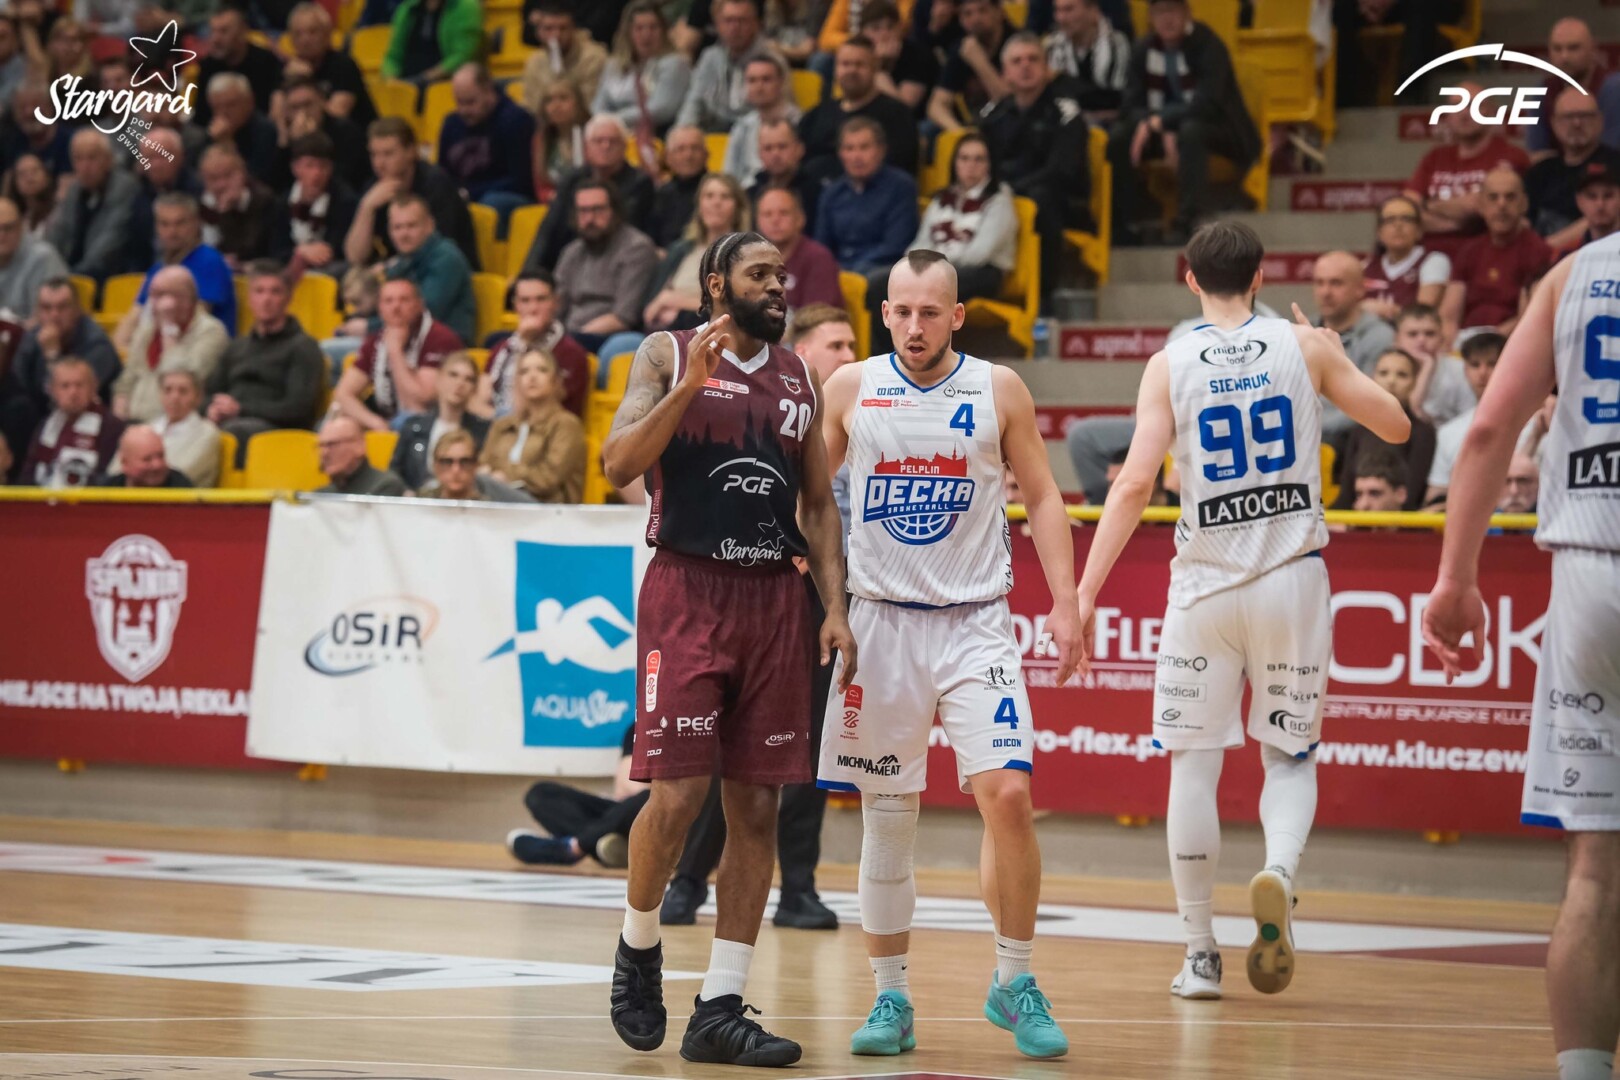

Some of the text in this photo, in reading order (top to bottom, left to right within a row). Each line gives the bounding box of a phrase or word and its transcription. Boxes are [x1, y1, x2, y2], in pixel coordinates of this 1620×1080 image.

[779, 398, 812, 443] 20
[949, 403, 975, 437] 4
[1198, 395, 1297, 482] 99
[722, 474, 775, 496] PGE
[900, 465, 940, 475] PELPLIN
[866, 478, 974, 510] DECKA
[887, 503, 949, 514] BASKETBALL
[1203, 489, 1306, 524] LATOCHA
[712, 537, 785, 567] Stargard
[993, 697, 1019, 730] 4
